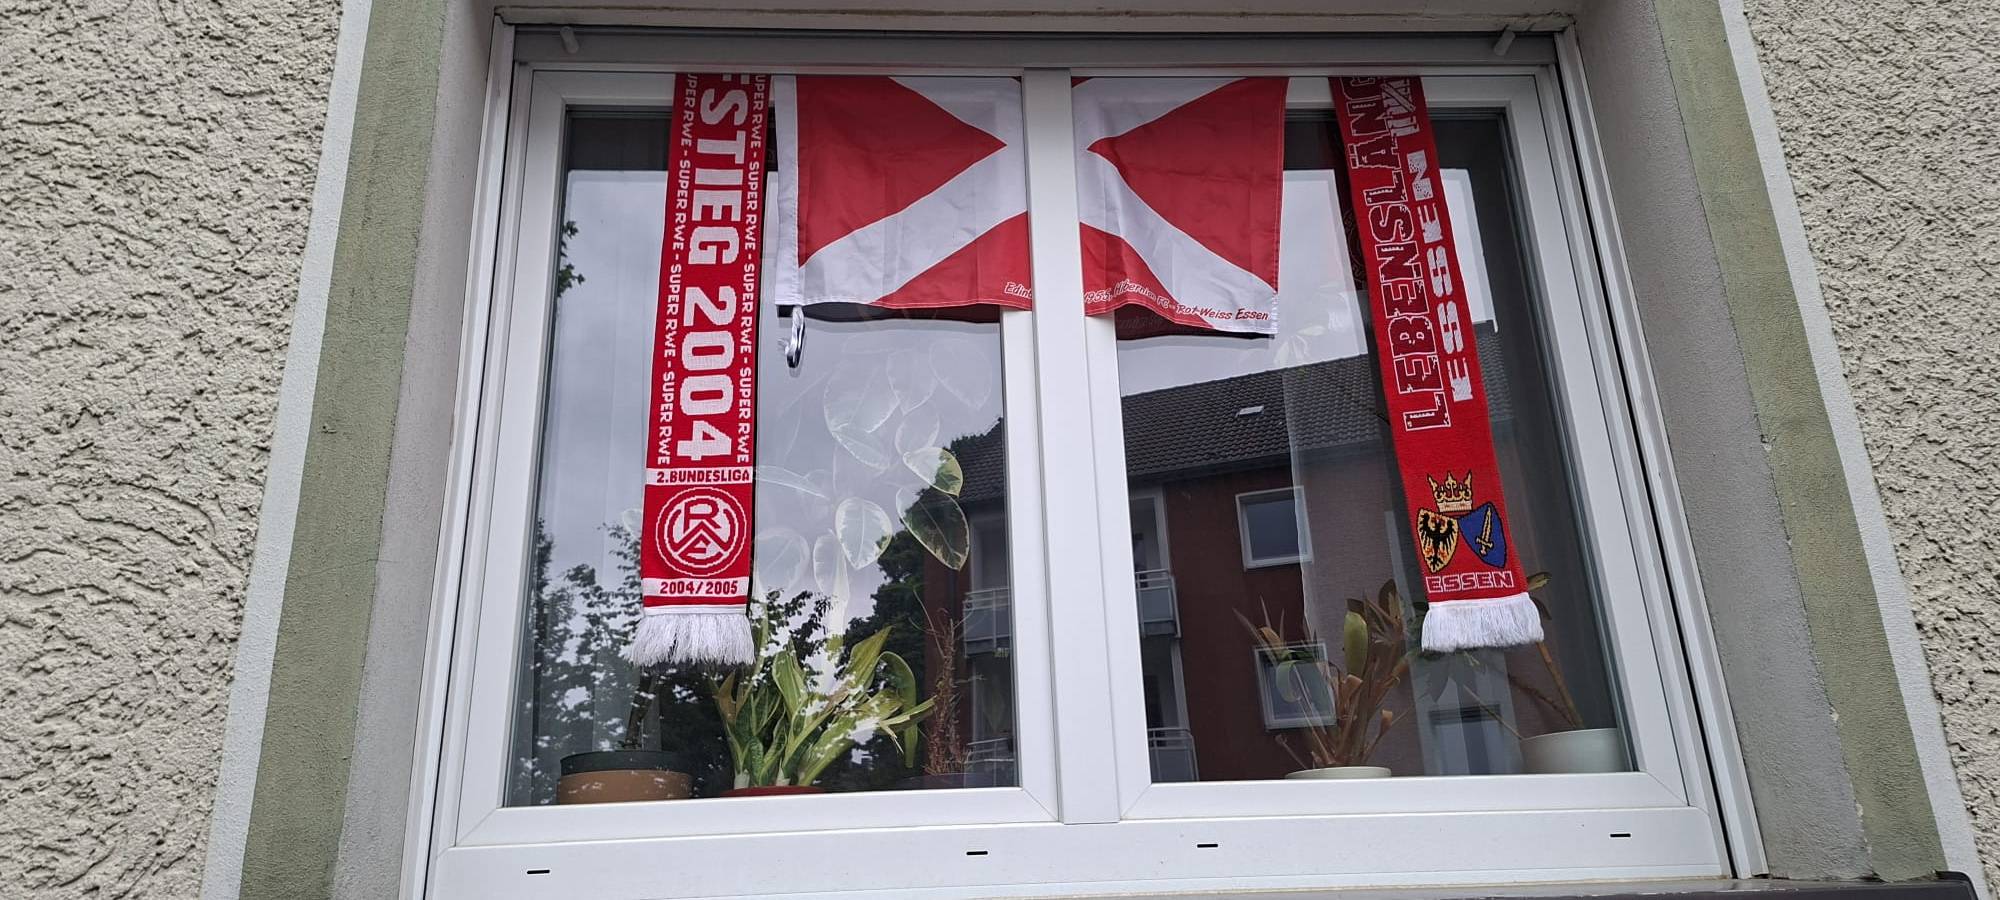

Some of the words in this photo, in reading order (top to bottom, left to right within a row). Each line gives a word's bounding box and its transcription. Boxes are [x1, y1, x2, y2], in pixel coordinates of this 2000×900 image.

[681, 111, 694, 147] RWE
[751, 114, 763, 149] RWE
[676, 159, 691, 210] SUPER
[687, 74, 750, 265] STIEG
[746, 161, 760, 210] SUPER
[672, 212, 687, 250] RWE
[744, 214, 757, 250] RWE
[666, 263, 682, 316] SUPER
[741, 263, 755, 313] SUPER
[1407, 150, 1473, 402] ESSEN
[1113, 278, 1157, 301] Hibernian
[1235, 308, 1269, 321] Essen
[664, 318, 678, 358] RWE
[740, 316, 753, 354] RWE
[676, 285, 737, 461] 2004
[739, 368, 752, 419] SUPER
[660, 371, 675, 423] SUPER
[657, 425, 672, 465] RWE
[737, 422, 750, 463] RWE
[656, 469, 750, 484] 2.BUNDESLIGA
[659, 580, 738, 595] 2004/2005
[1426, 571, 1515, 593] ESSEN
